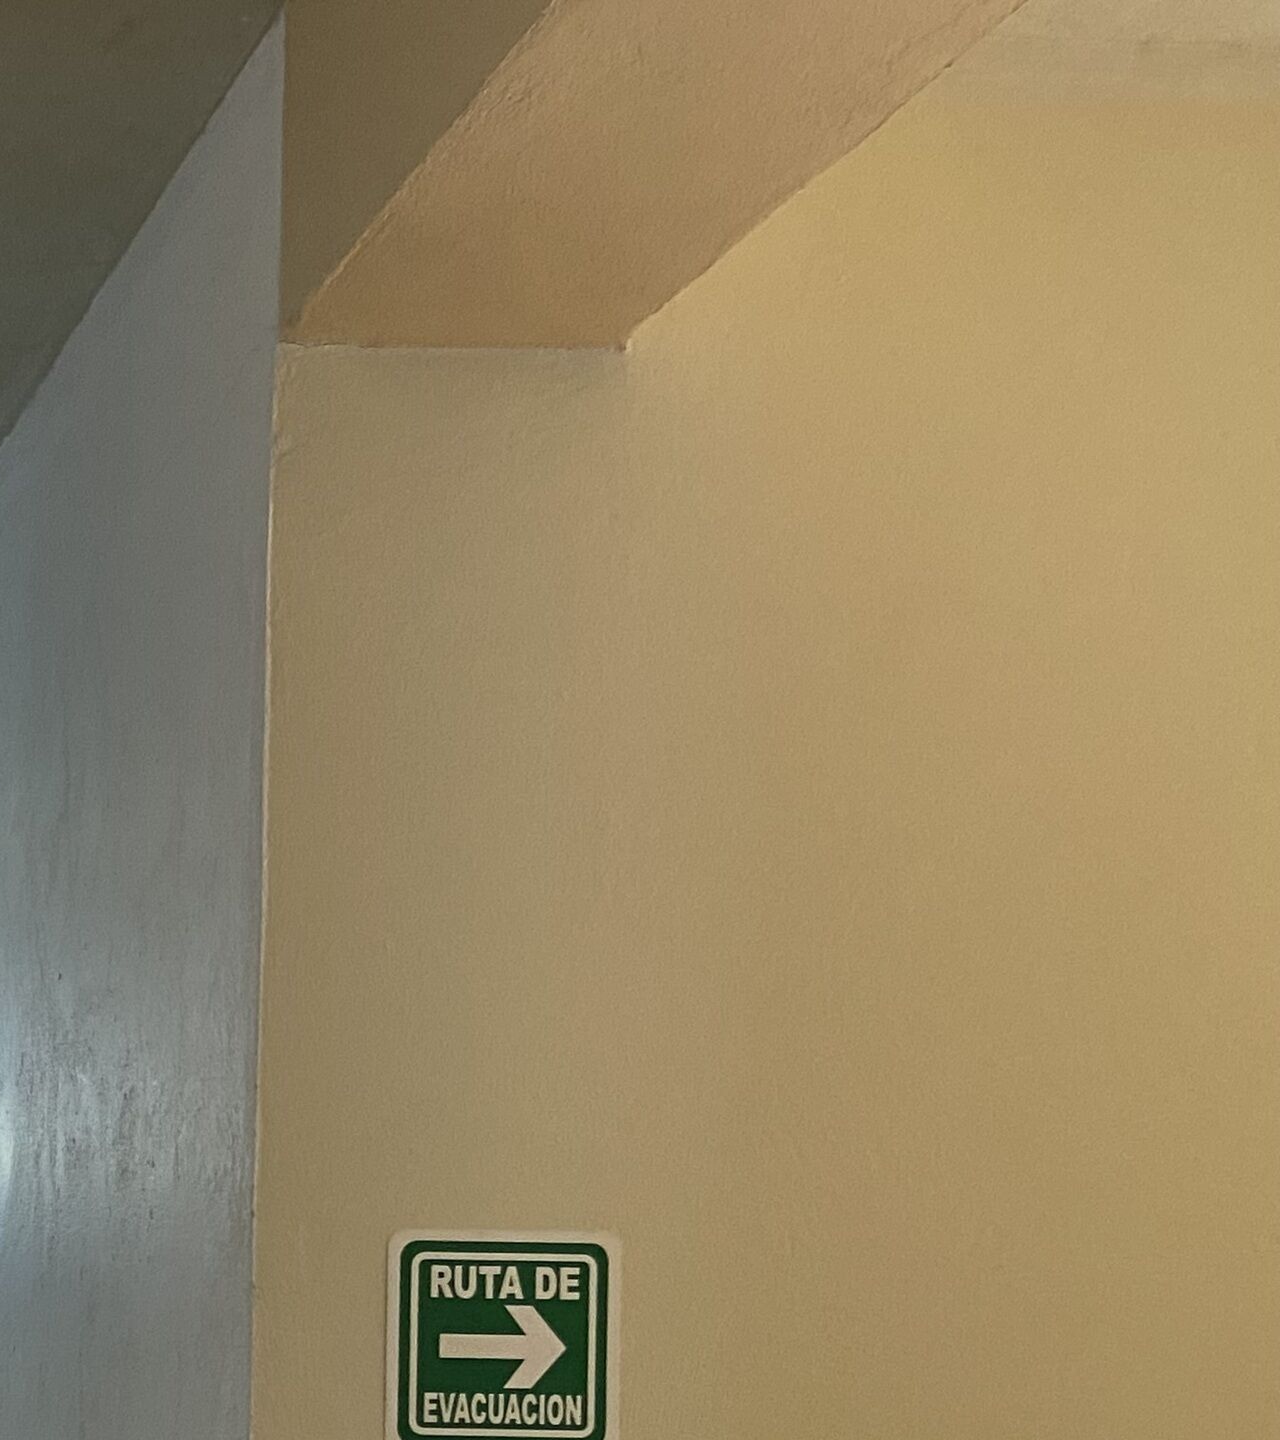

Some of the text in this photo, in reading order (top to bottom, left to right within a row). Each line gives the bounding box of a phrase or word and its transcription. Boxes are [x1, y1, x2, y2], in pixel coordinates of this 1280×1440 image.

[430, 1264, 581, 1301] RUTA DE
[423, 1392, 582, 1426] EVACUACION
